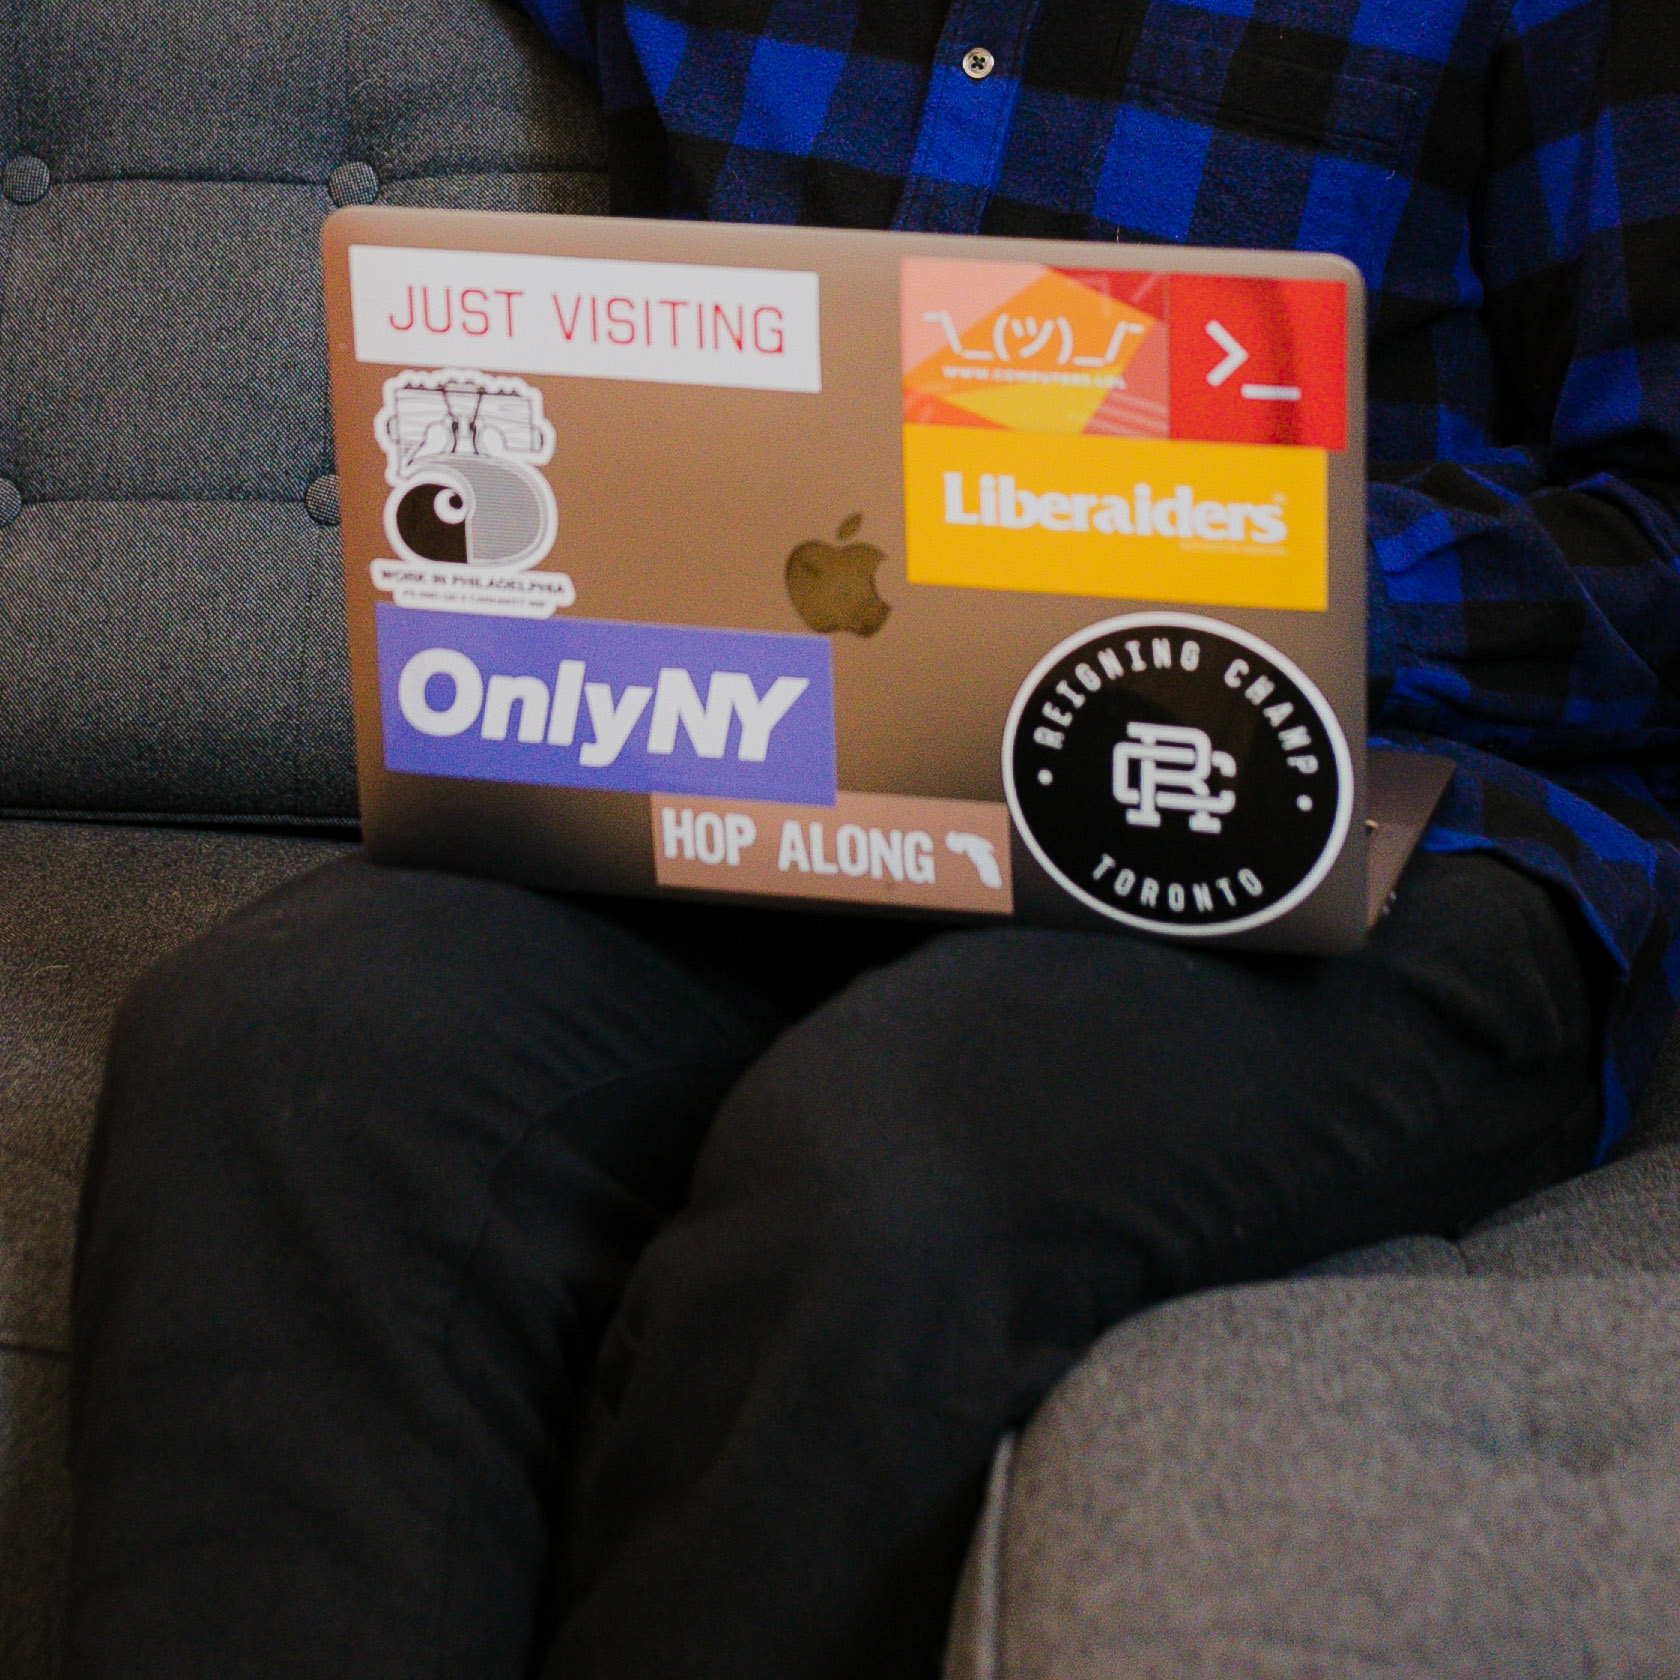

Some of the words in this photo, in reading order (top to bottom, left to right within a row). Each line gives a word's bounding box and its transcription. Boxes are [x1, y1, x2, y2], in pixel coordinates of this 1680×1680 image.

[388, 284, 524, 338] JUST
[551, 293, 785, 355] VISITING
[942, 471, 1288, 545] Liberaiders
[1033, 637, 1200, 750] REIGNING
[1224, 658, 1319, 774] CHAMP
[661, 807, 757, 867] HOP
[778, 821, 937, 884] ALONG
[1092, 853, 1263, 913] TORONTO
